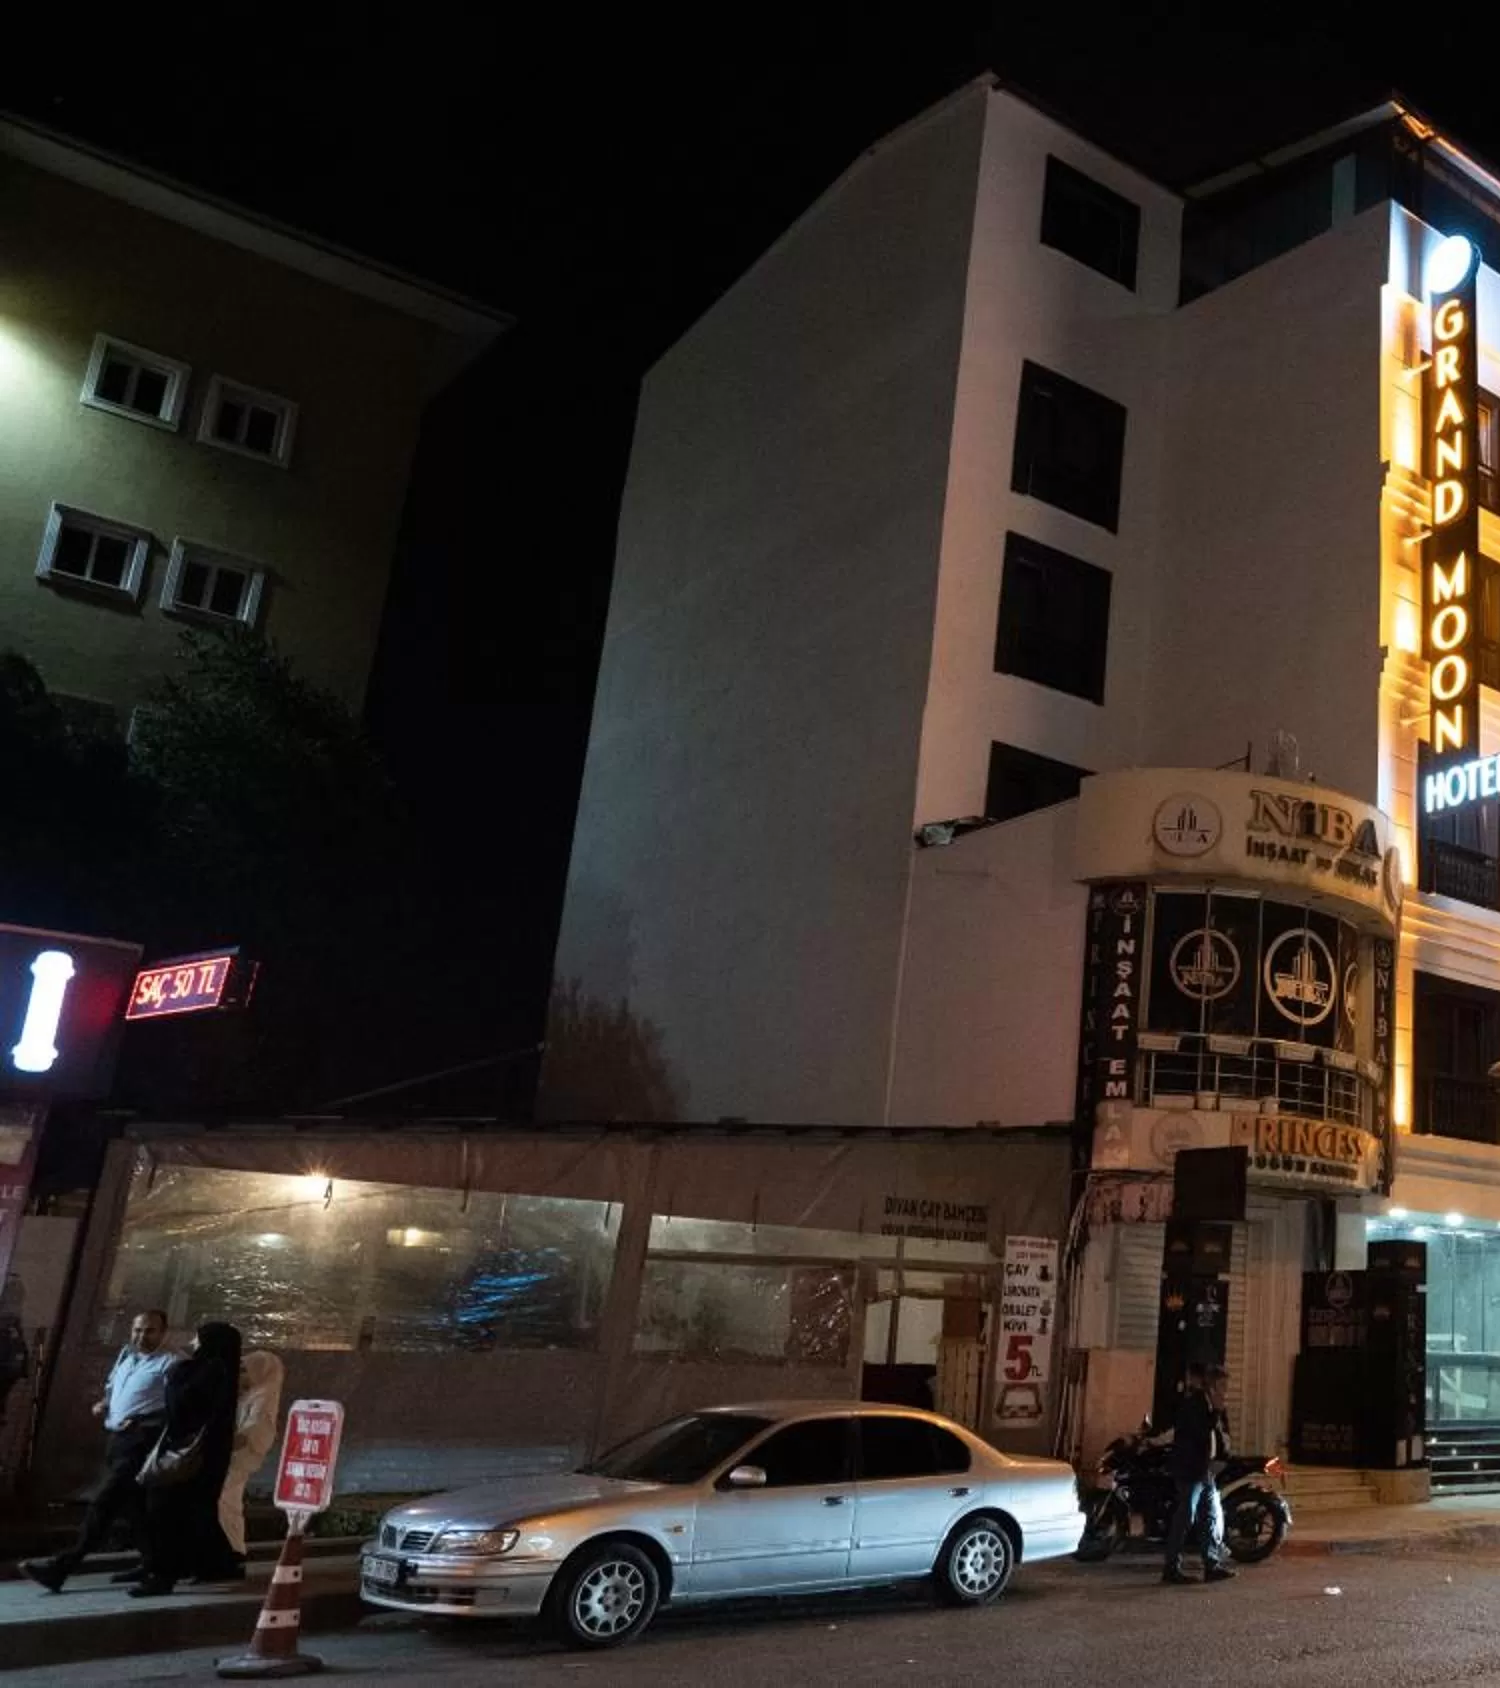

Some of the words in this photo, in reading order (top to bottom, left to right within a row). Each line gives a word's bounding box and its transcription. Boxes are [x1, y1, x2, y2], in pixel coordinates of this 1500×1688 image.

[1433, 299, 1465, 522] GRAND
[1432, 551, 1468, 753] MOON
[136, 974, 171, 1008] SAÇ
[170, 969, 194, 999] 50
[198, 965, 217, 995] TL
[1004, 1335, 1033, 1380] 5
